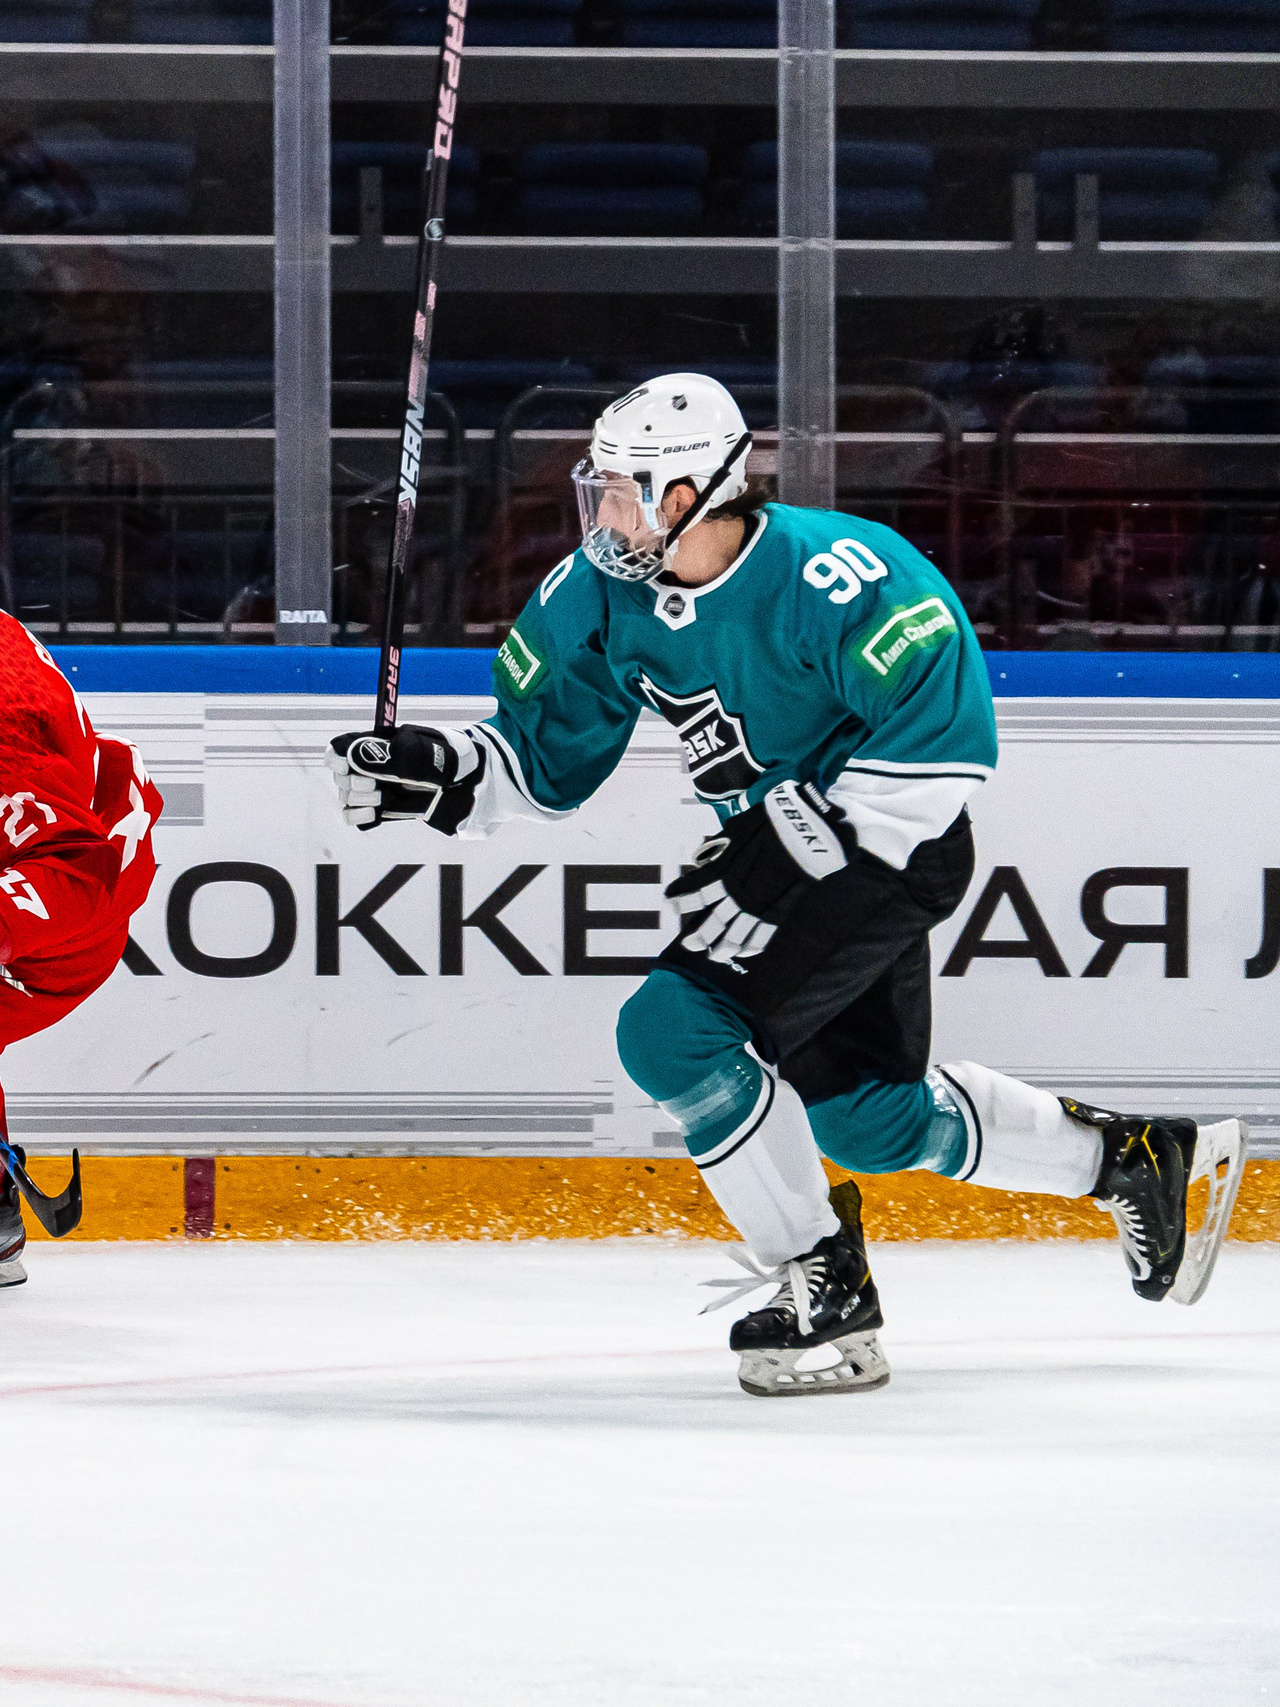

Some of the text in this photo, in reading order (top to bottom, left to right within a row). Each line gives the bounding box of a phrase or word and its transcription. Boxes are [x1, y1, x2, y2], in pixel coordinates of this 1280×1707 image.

[397, 398, 425, 508] NBSK
[662, 440, 711, 455] BAUER
[803, 538, 888, 604] 90
[383, 646, 400, 728] ЗАРЯ
[498, 641, 525, 684] СТАВОК
[682, 719, 726, 764] BSK
[115, 860, 1190, 980] ОККЕАЯ
